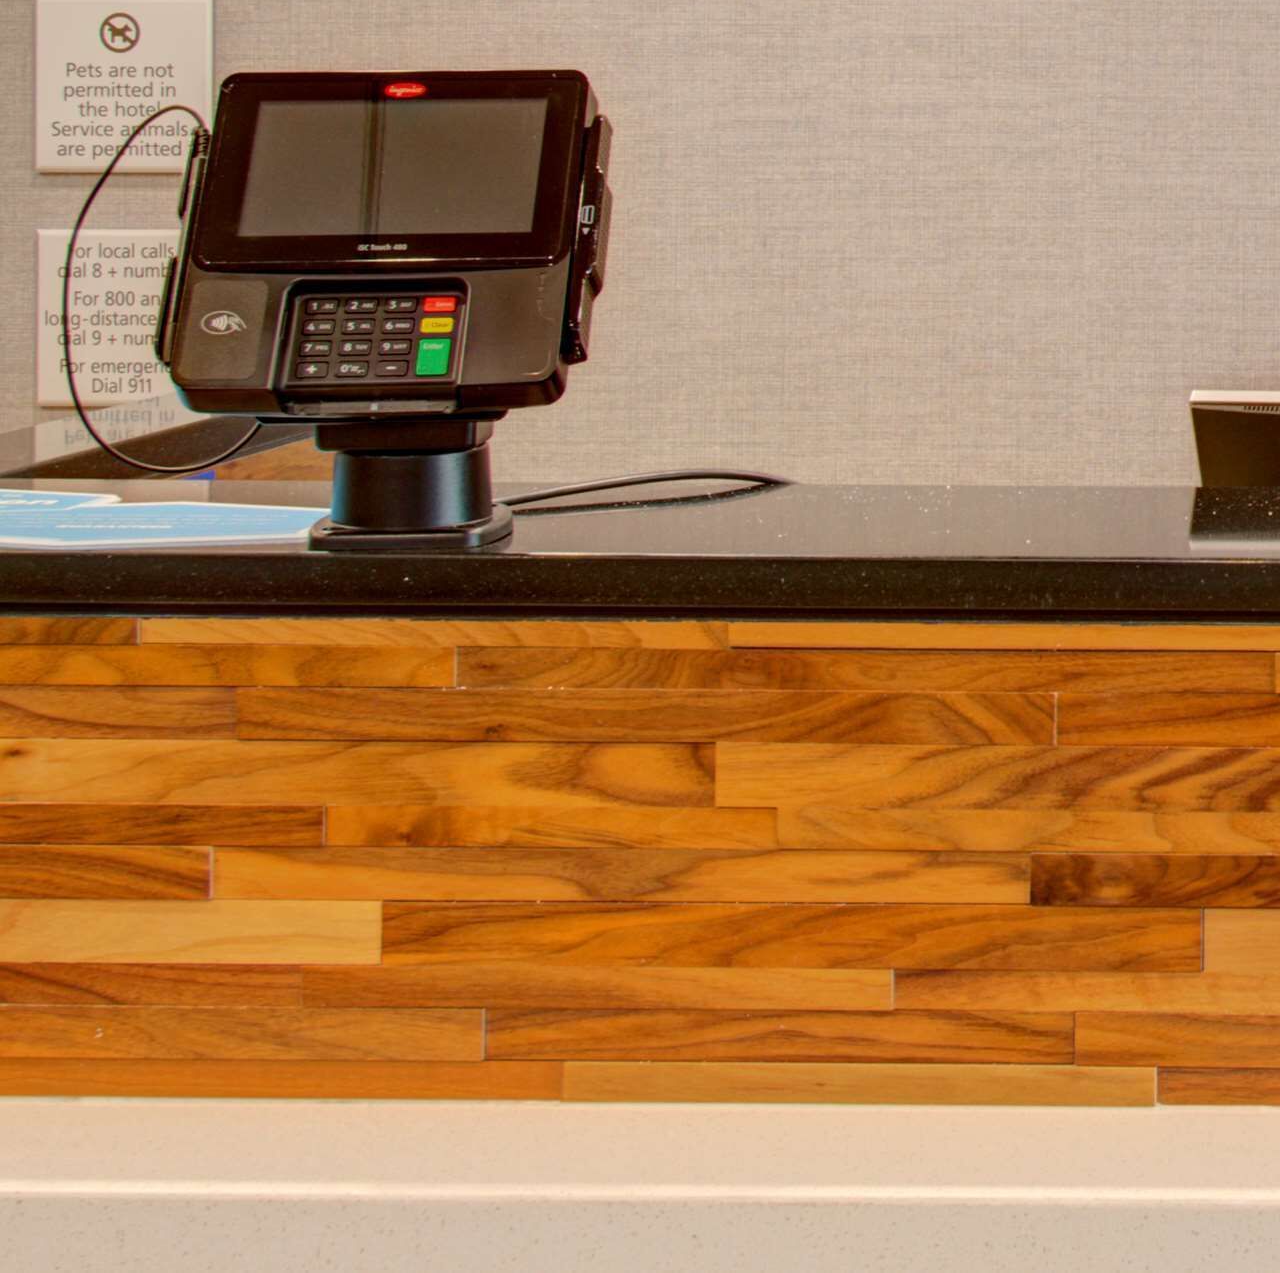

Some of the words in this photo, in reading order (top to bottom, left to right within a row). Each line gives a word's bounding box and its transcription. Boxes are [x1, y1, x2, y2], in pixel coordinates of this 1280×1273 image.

[65, 62, 103, 78] Pets
[108, 65, 137, 78] are
[143, 63, 175, 78] not
[63, 81, 154, 102] permitted
[160, 81, 177, 98] in
[78, 100, 109, 117] the
[51, 120, 114, 137] Service
[56, 143, 86, 157] are
[71, 244, 93, 258] or
[98, 242, 135, 258] local
[57, 262, 87, 279] dal
[92, 262, 103, 279] 8
[107, 266, 117, 278] +
[73, 290, 100, 307] For
[104, 290, 136, 307] 800
[44, 309, 158, 331] log-distance
[57, 330, 87, 345] dal
[91, 330, 102, 345] 9
[107, 334, 117, 345] +
[92, 378, 123, 394] Dial
[127, 378, 152, 394] 911
